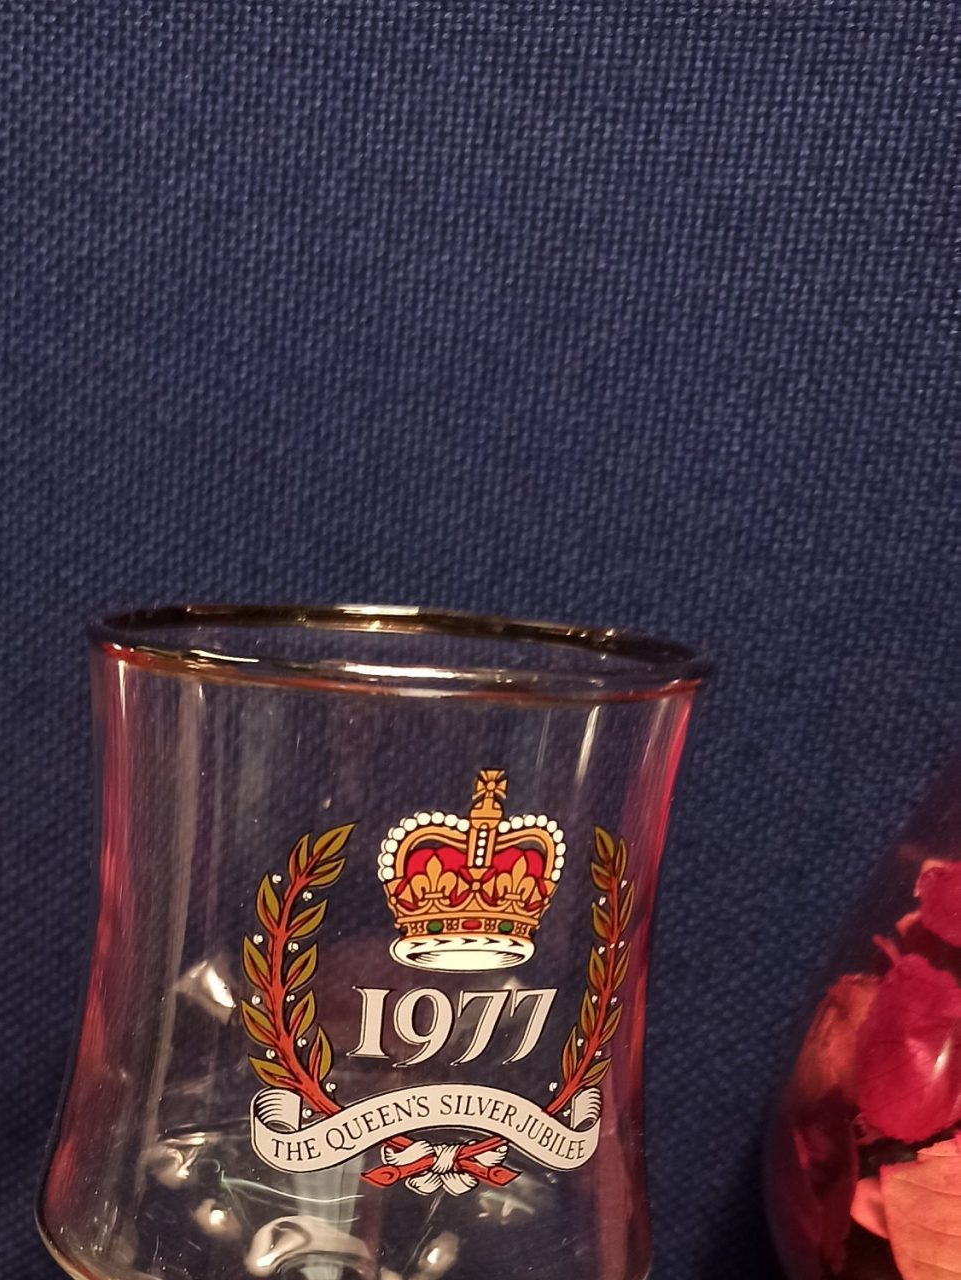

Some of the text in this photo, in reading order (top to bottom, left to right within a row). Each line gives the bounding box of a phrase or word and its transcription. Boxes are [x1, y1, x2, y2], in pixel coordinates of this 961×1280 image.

[346, 985, 558, 1068] 1977
[271, 1093, 585, 1161] THE QUEEN'S SILVER JUBILEE
